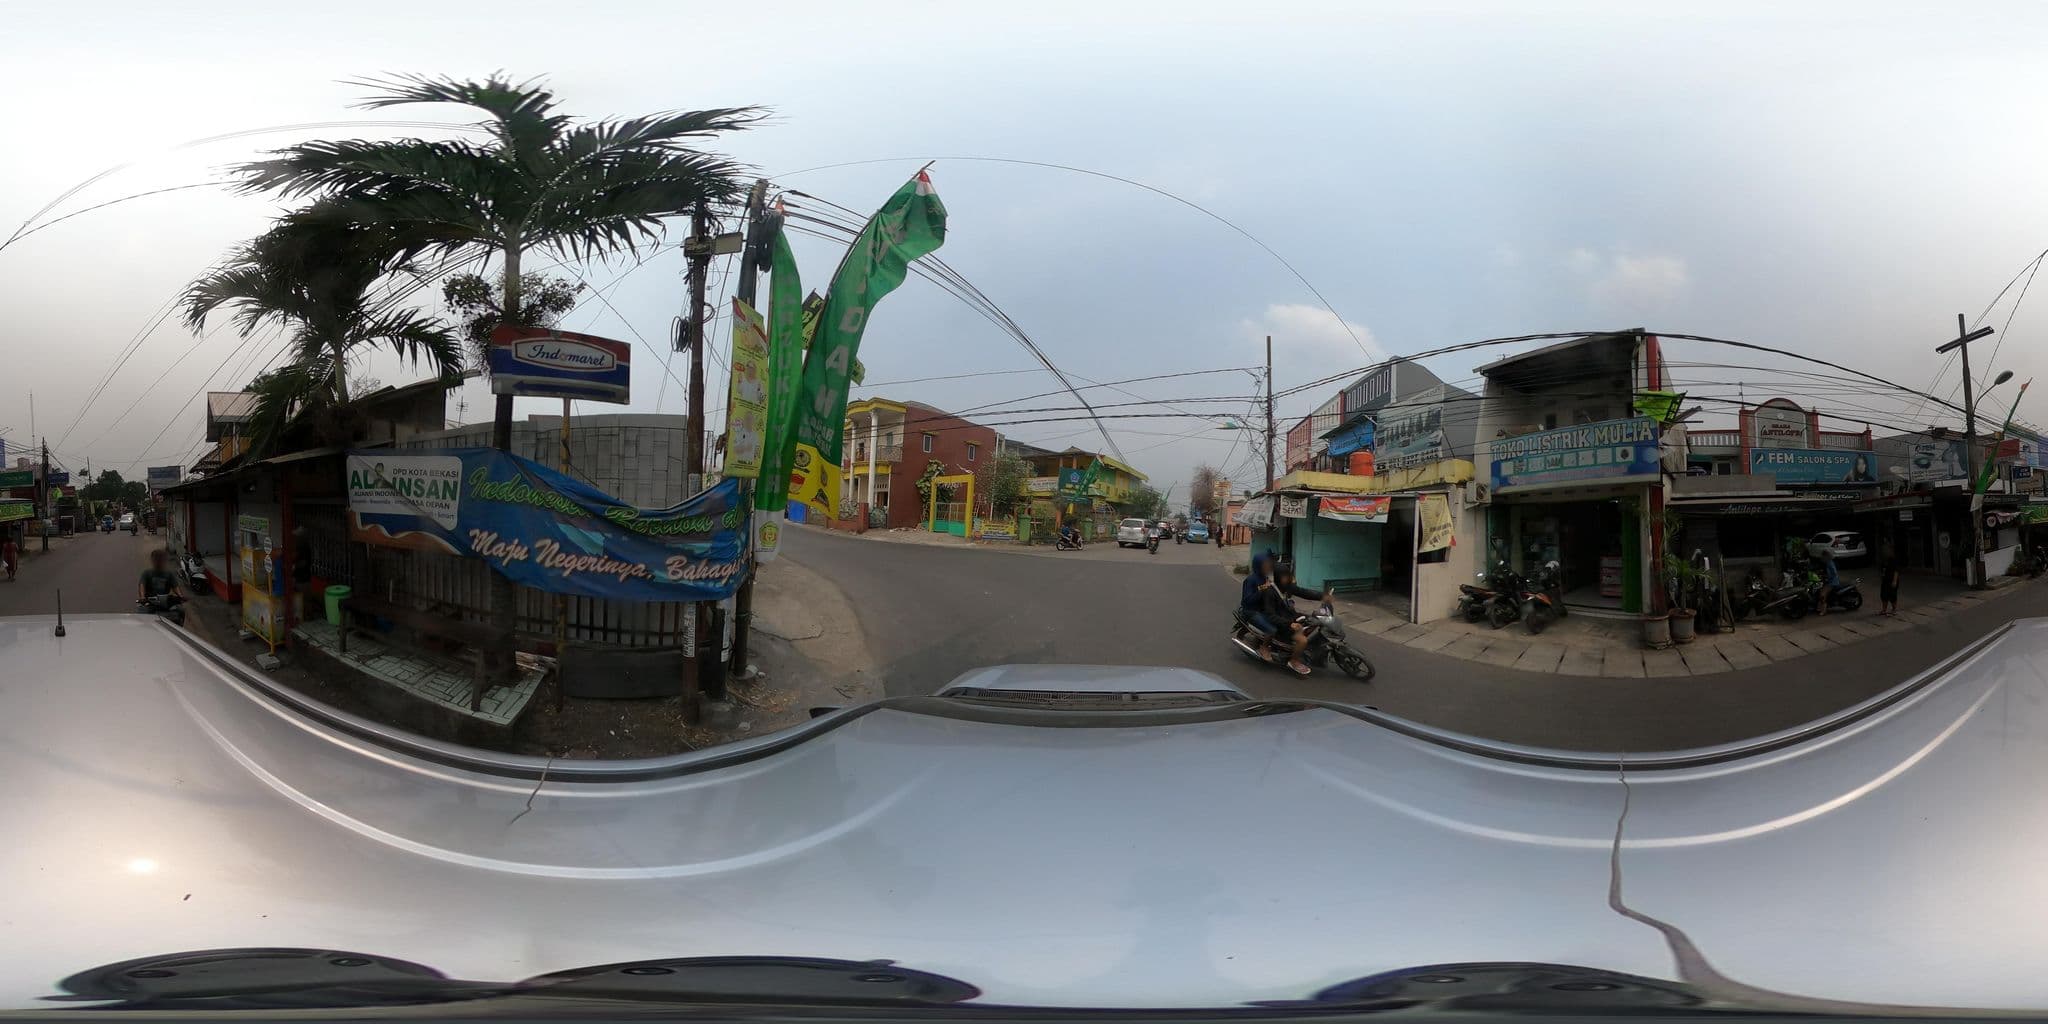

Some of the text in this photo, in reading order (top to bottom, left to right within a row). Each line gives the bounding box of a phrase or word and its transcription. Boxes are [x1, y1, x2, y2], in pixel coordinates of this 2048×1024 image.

[527, 344, 605, 367] Indomaret
[1490, 421, 1654, 461] TOKO LISTRIK MULIA
[1768, 452, 1850, 465] FEM SALON & SPA
[351, 470, 375, 490] AL
[392, 468, 459, 478] DPD KOTA BEKASI
[469, 466, 593, 519] Indonesi
[469, 528, 746, 586] Maju Negerinya, Bahagi
